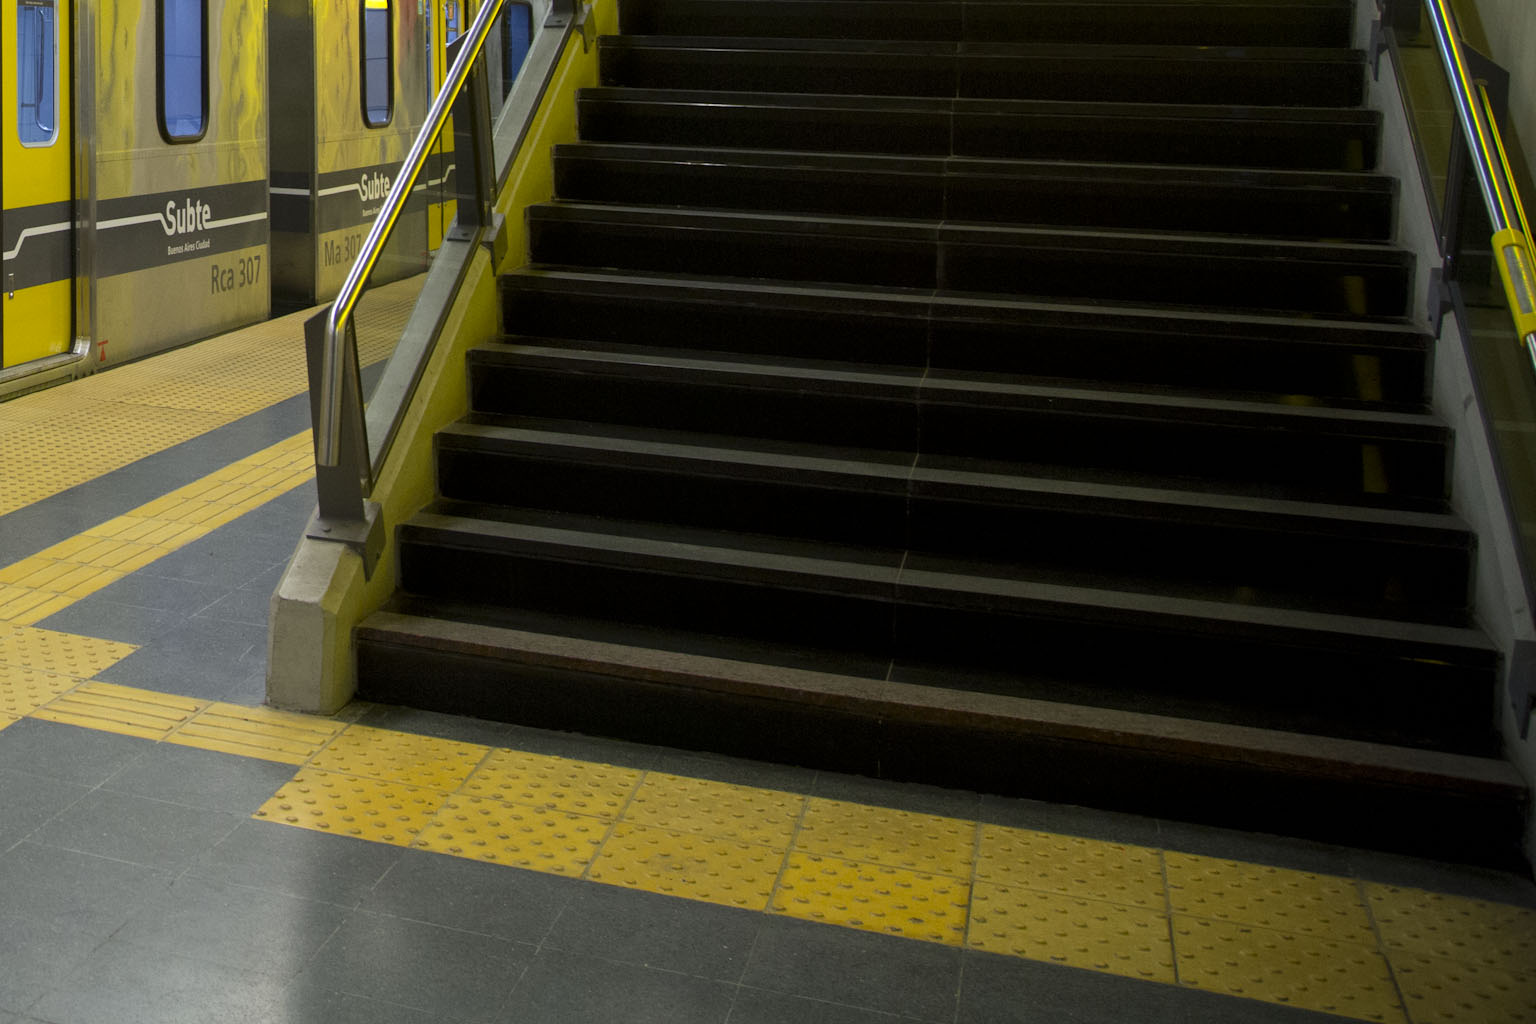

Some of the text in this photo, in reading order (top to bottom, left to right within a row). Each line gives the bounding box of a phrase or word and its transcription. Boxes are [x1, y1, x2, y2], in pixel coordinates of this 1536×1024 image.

[360, 171, 390, 202] Subte
[166, 198, 211, 236] Subte
[168, 238, 211, 256] Buenos Aires Ciudad
[324, 233, 362, 267] Ma 307
[211, 255, 261, 295] Rca 307
